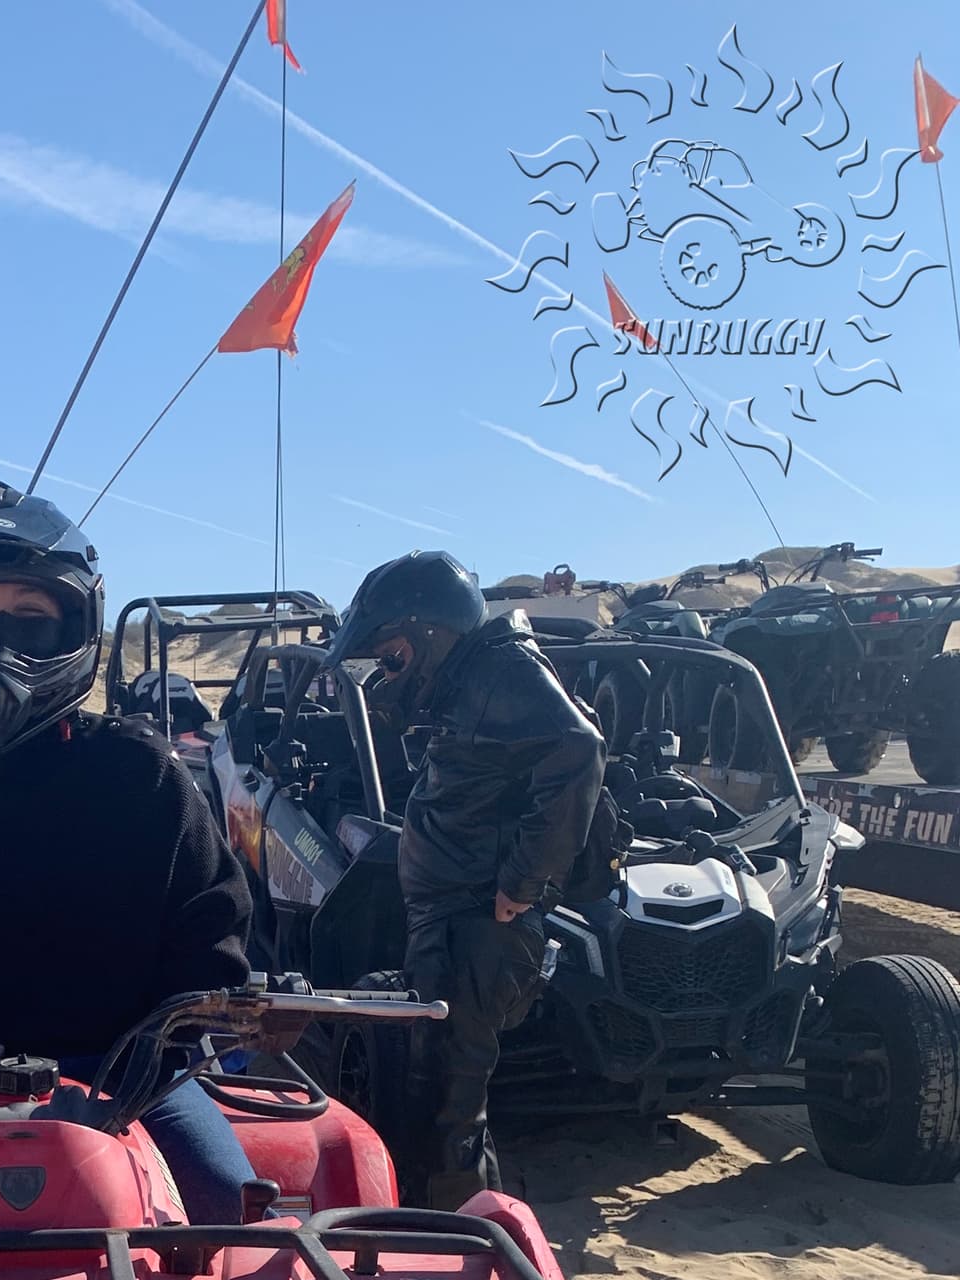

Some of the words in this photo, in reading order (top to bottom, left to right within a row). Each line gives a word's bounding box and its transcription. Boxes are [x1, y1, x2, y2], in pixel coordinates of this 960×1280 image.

[859, 803, 900, 837] THE
[903, 810, 954, 844] FUN
[295, 828, 324, 866] UM001
